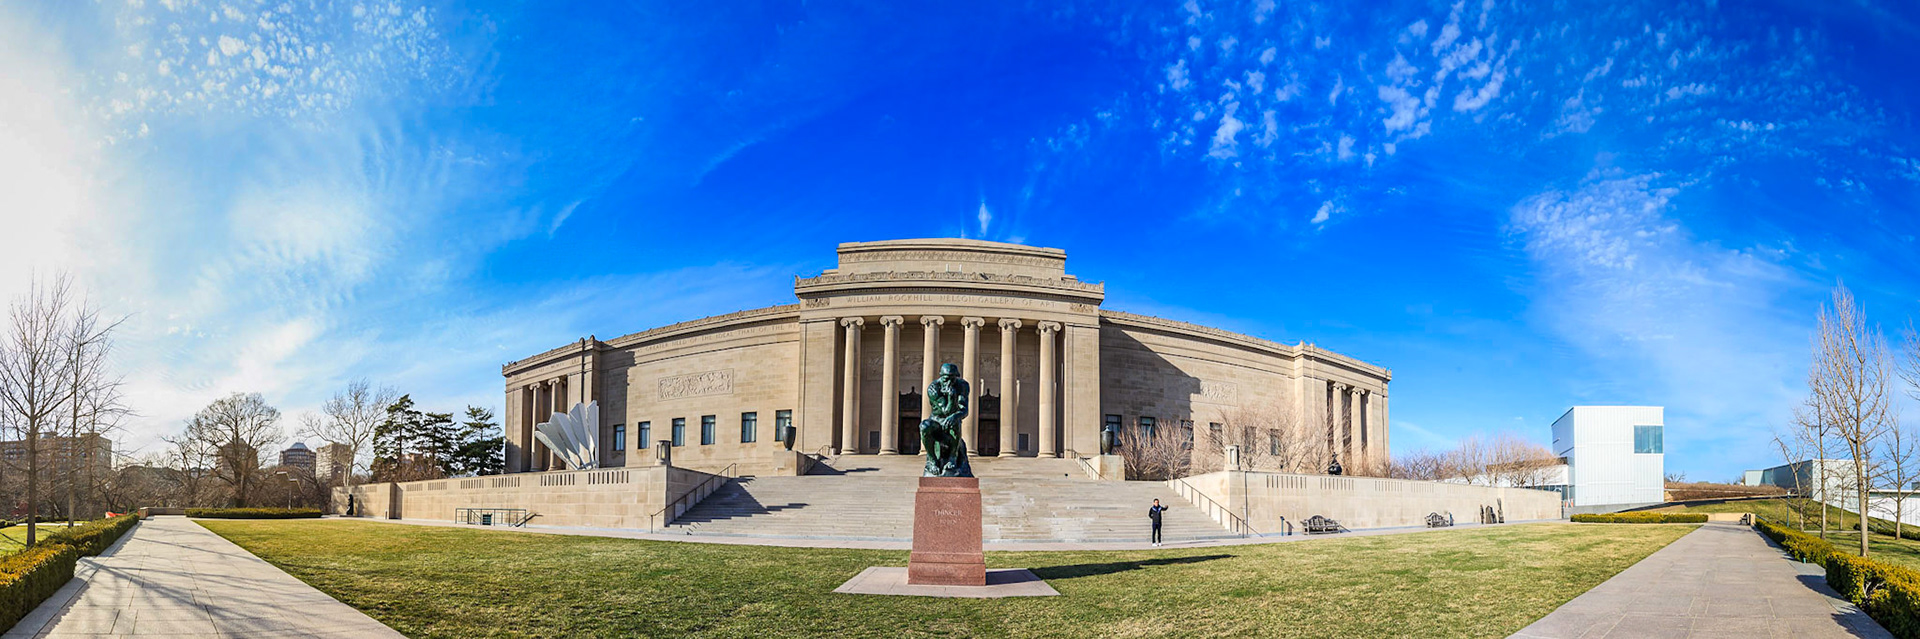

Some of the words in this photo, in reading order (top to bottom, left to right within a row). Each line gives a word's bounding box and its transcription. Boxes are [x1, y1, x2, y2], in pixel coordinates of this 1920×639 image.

[846, 295, 881, 303] WILLIAM
[888, 294, 933, 302] ROCKHILL
[939, 294, 973, 302] NELSON
[978, 296, 1016, 304] GALLERY
[1022, 298, 1033, 306] OF
[1040, 300, 1056, 308] ART
[932, 509, 963, 517] THINKER
